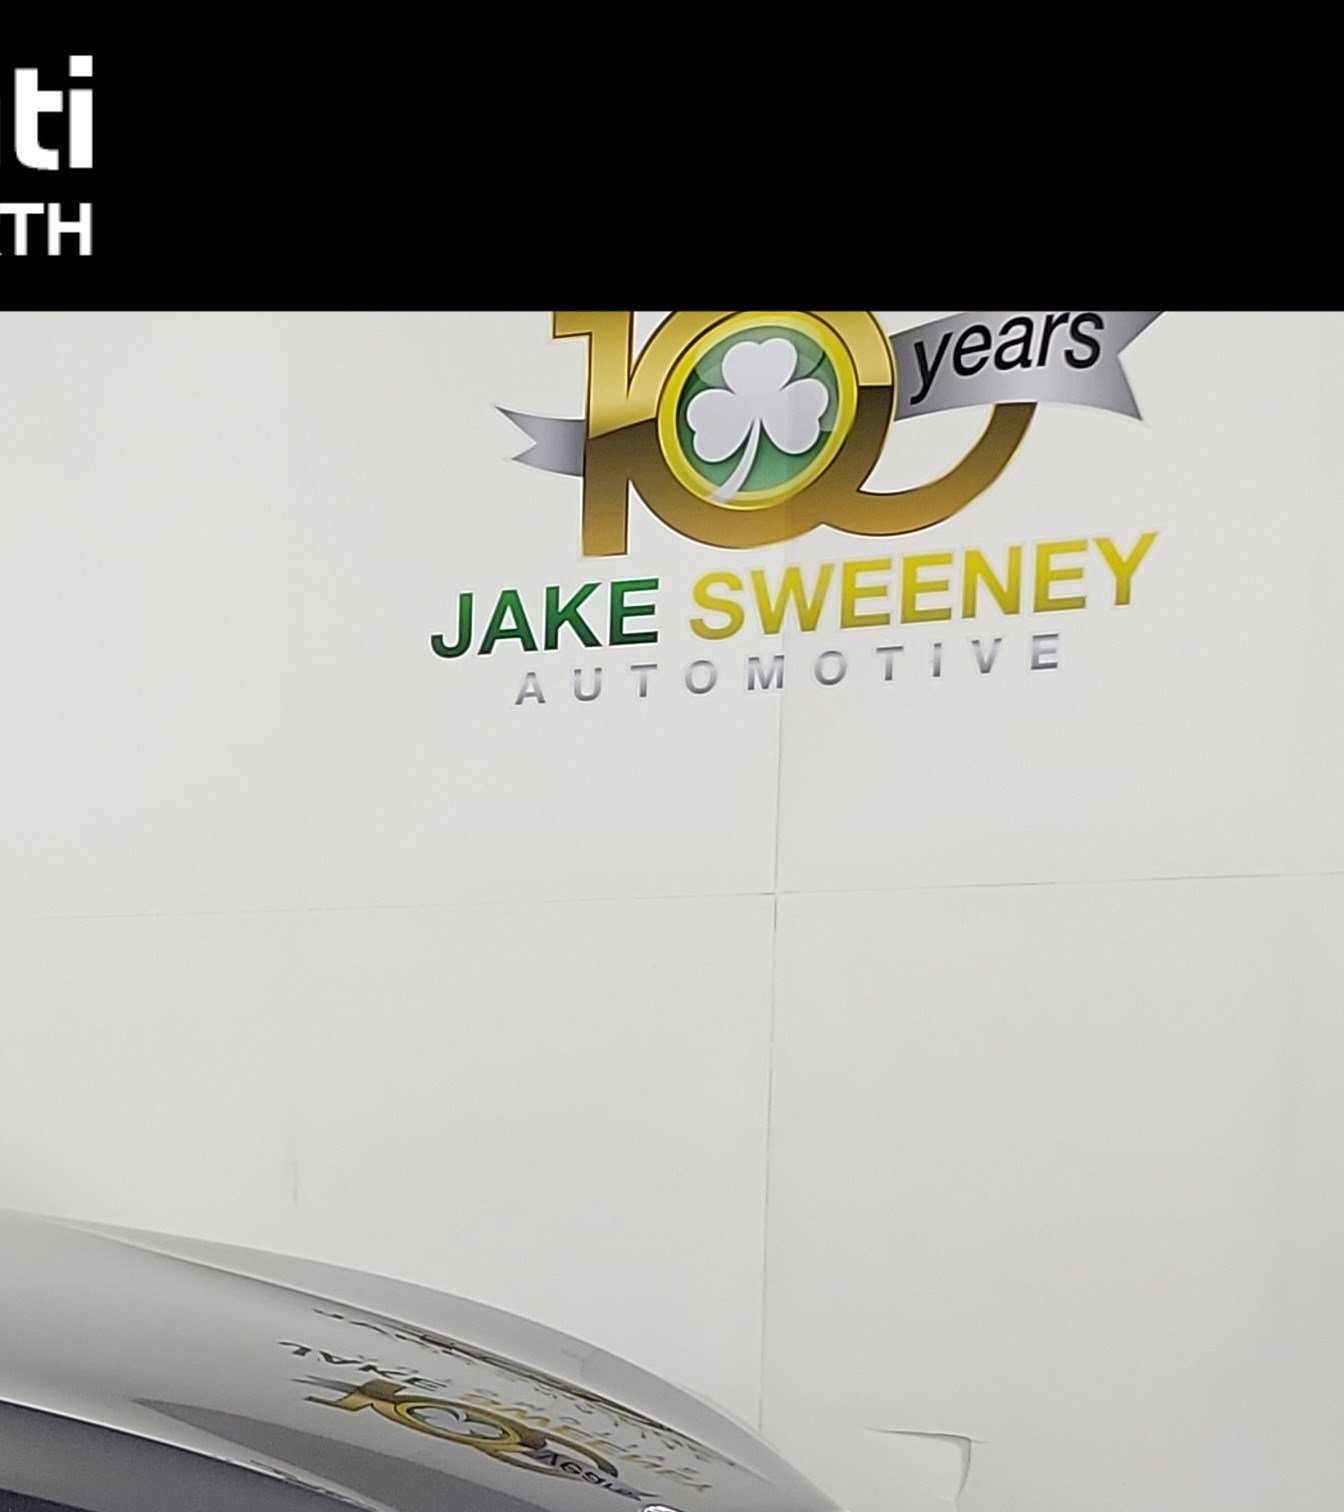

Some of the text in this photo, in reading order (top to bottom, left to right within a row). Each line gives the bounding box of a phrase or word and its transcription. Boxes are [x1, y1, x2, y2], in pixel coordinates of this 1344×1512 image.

[911, 312, 1102, 405] years
[430, 531, 1159, 658] JAKE SWEENEY
[515, 633, 1059, 705] AUTOMOTIVE
